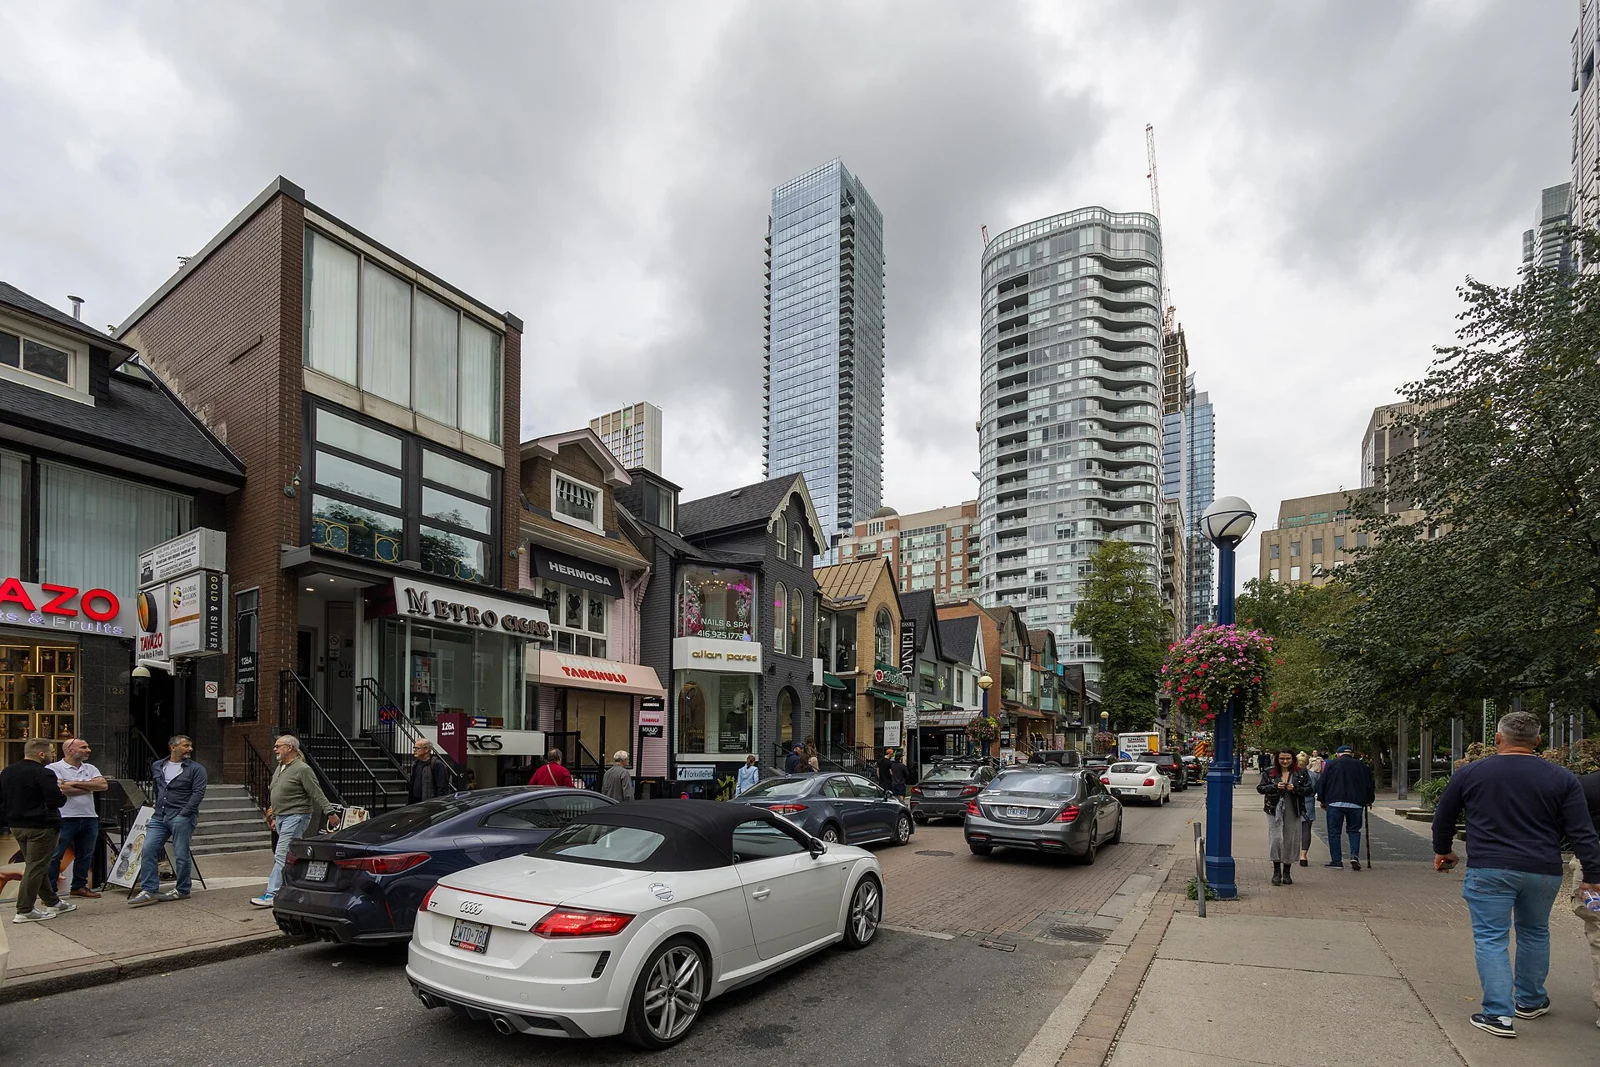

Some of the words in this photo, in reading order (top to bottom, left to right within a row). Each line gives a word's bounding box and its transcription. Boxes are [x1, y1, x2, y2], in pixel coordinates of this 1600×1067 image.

[548, 561, 612, 587] HERMOSA
[210, 576, 218, 602] GOLD
[28, 612, 45, 625] &
[52, 616, 125, 635] Fruits
[404, 587, 499, 629] METRO
[501, 614, 551, 638] CIGAR
[701, 618, 724, 627] NAILS
[726, 620, 732, 628] &
[733, 621, 749, 629] SPA
[210, 615, 218, 648] SILVER
[692, 650, 722, 659] allan
[902, 628, 914, 675] DANIEL
[562, 666, 628, 684] TANGHULU
[108, 687, 125, 695] 128
[441, 722, 455, 731] 126A
